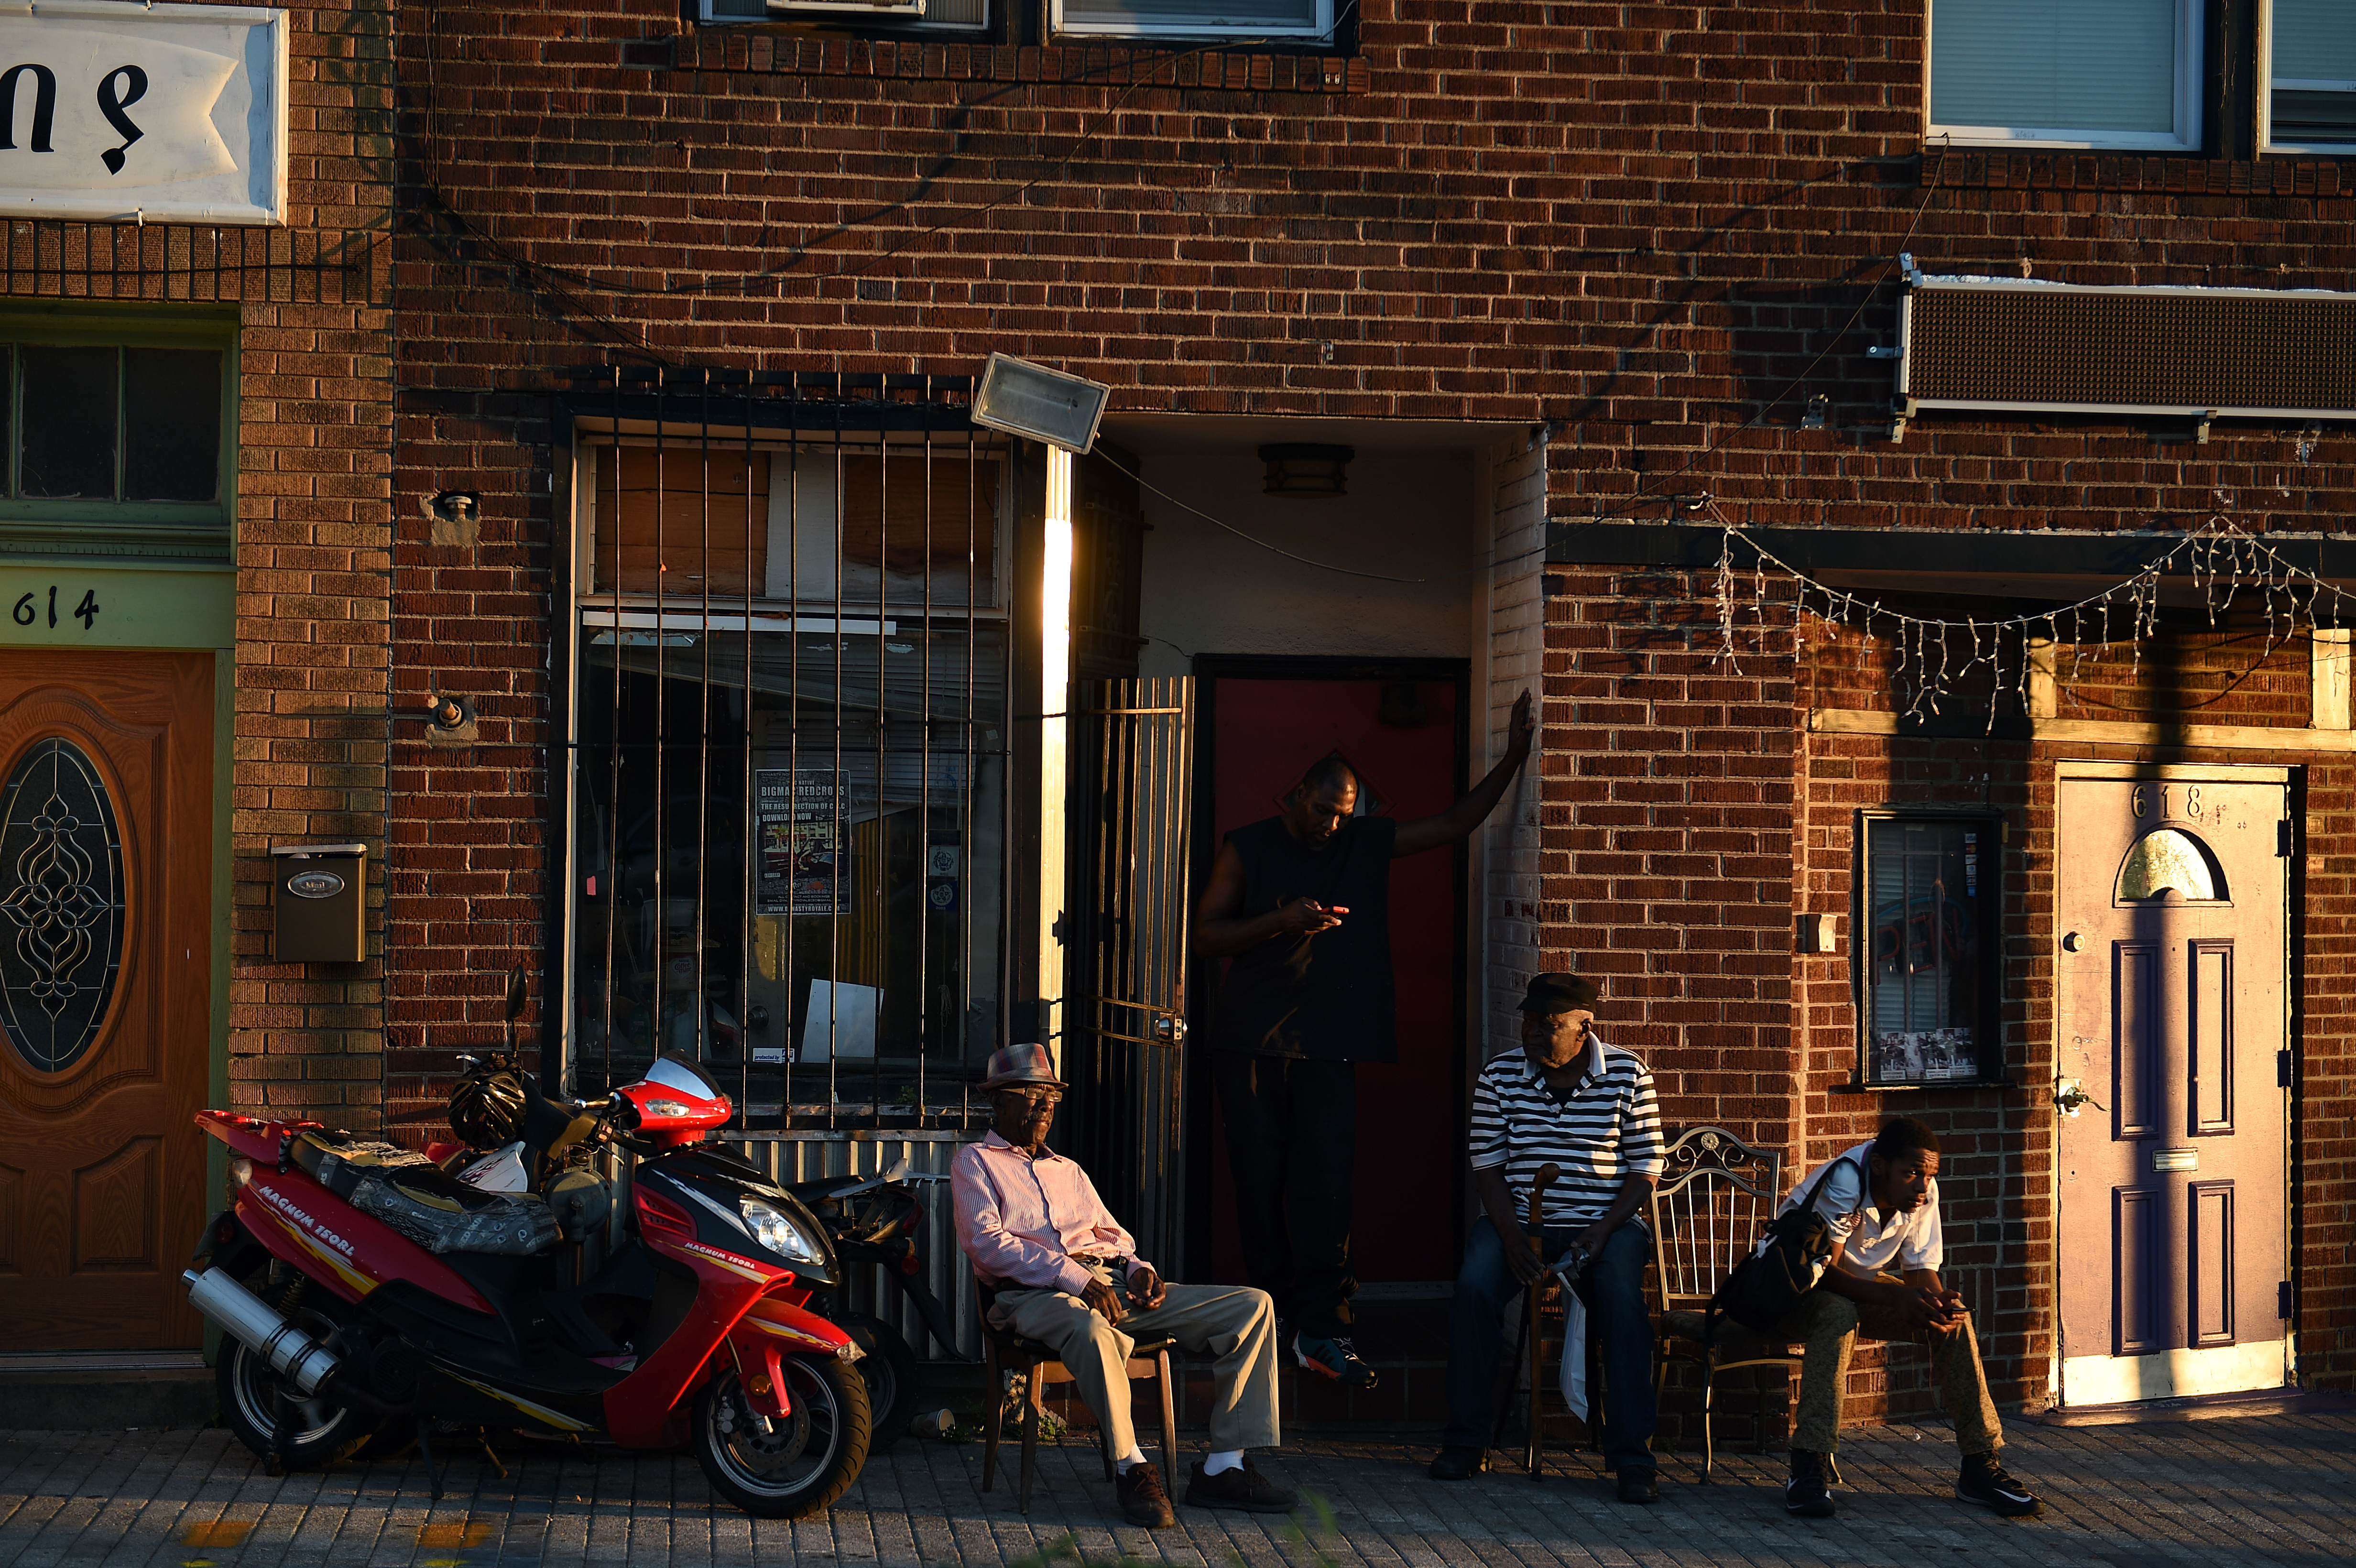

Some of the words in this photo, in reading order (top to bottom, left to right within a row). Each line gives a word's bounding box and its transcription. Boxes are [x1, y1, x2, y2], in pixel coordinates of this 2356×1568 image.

[13, 586, 99, 630] 614
[799, 786, 845, 796] REDCROS
[2132, 784, 2201, 818] 618
[762, 813, 796, 822] DOWNLO
[797, 812, 812, 820] NOW
[259, 1186, 316, 1228] MAGNUM
[314, 1224, 355, 1256] 150RL
[684, 1242, 726, 1260] MAGNUM
